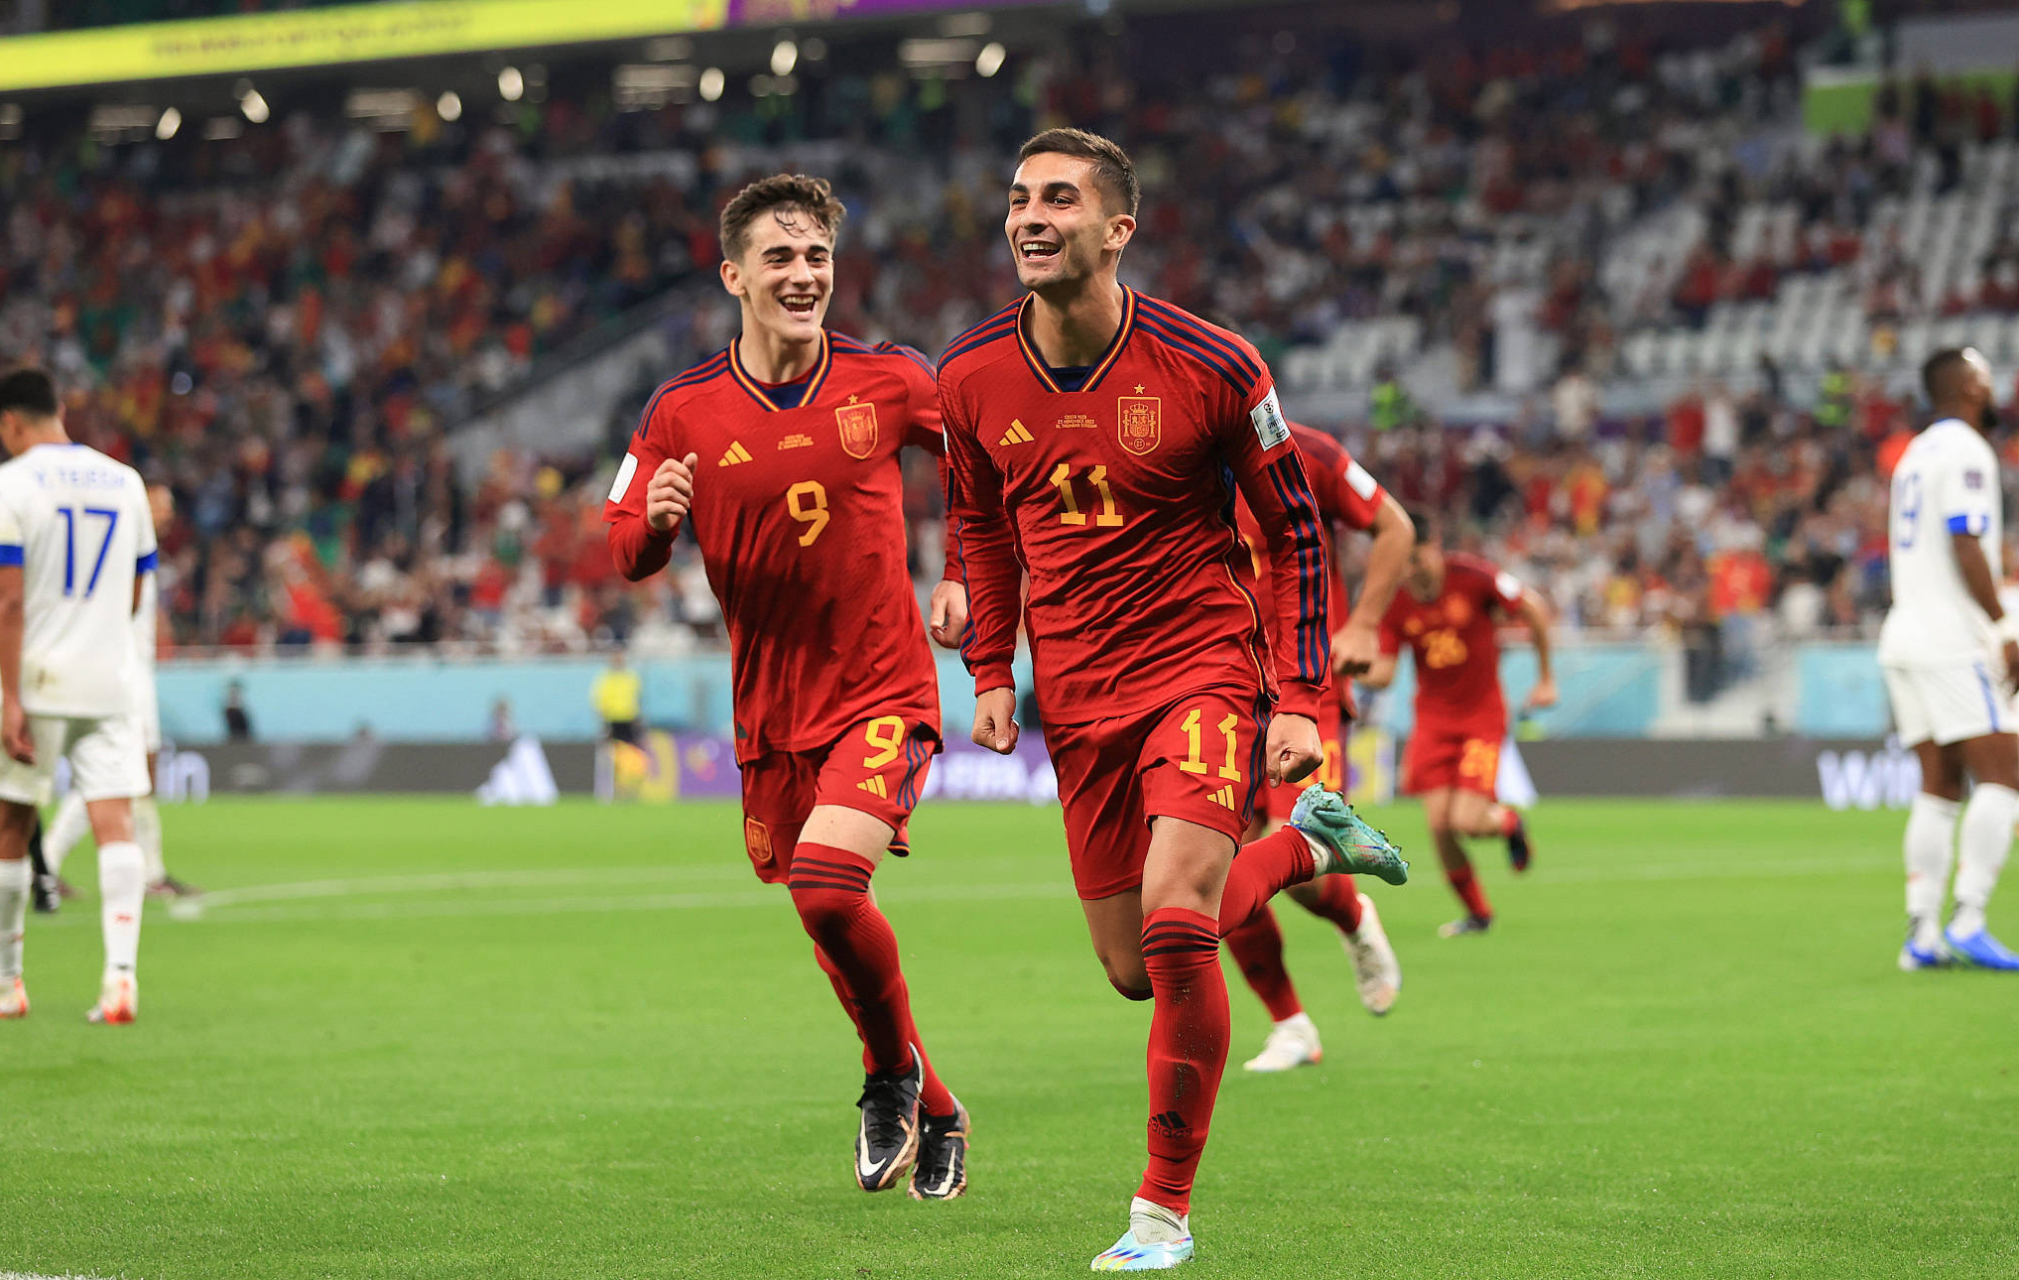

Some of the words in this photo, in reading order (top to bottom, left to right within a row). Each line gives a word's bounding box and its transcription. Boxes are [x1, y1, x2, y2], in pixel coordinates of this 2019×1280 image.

[786, 480, 830, 547] 9
[1049, 463, 1124, 526] 11
[56, 507, 118, 598] 17
[863, 716, 905, 769] 9
[1179, 709, 1241, 782] 11
